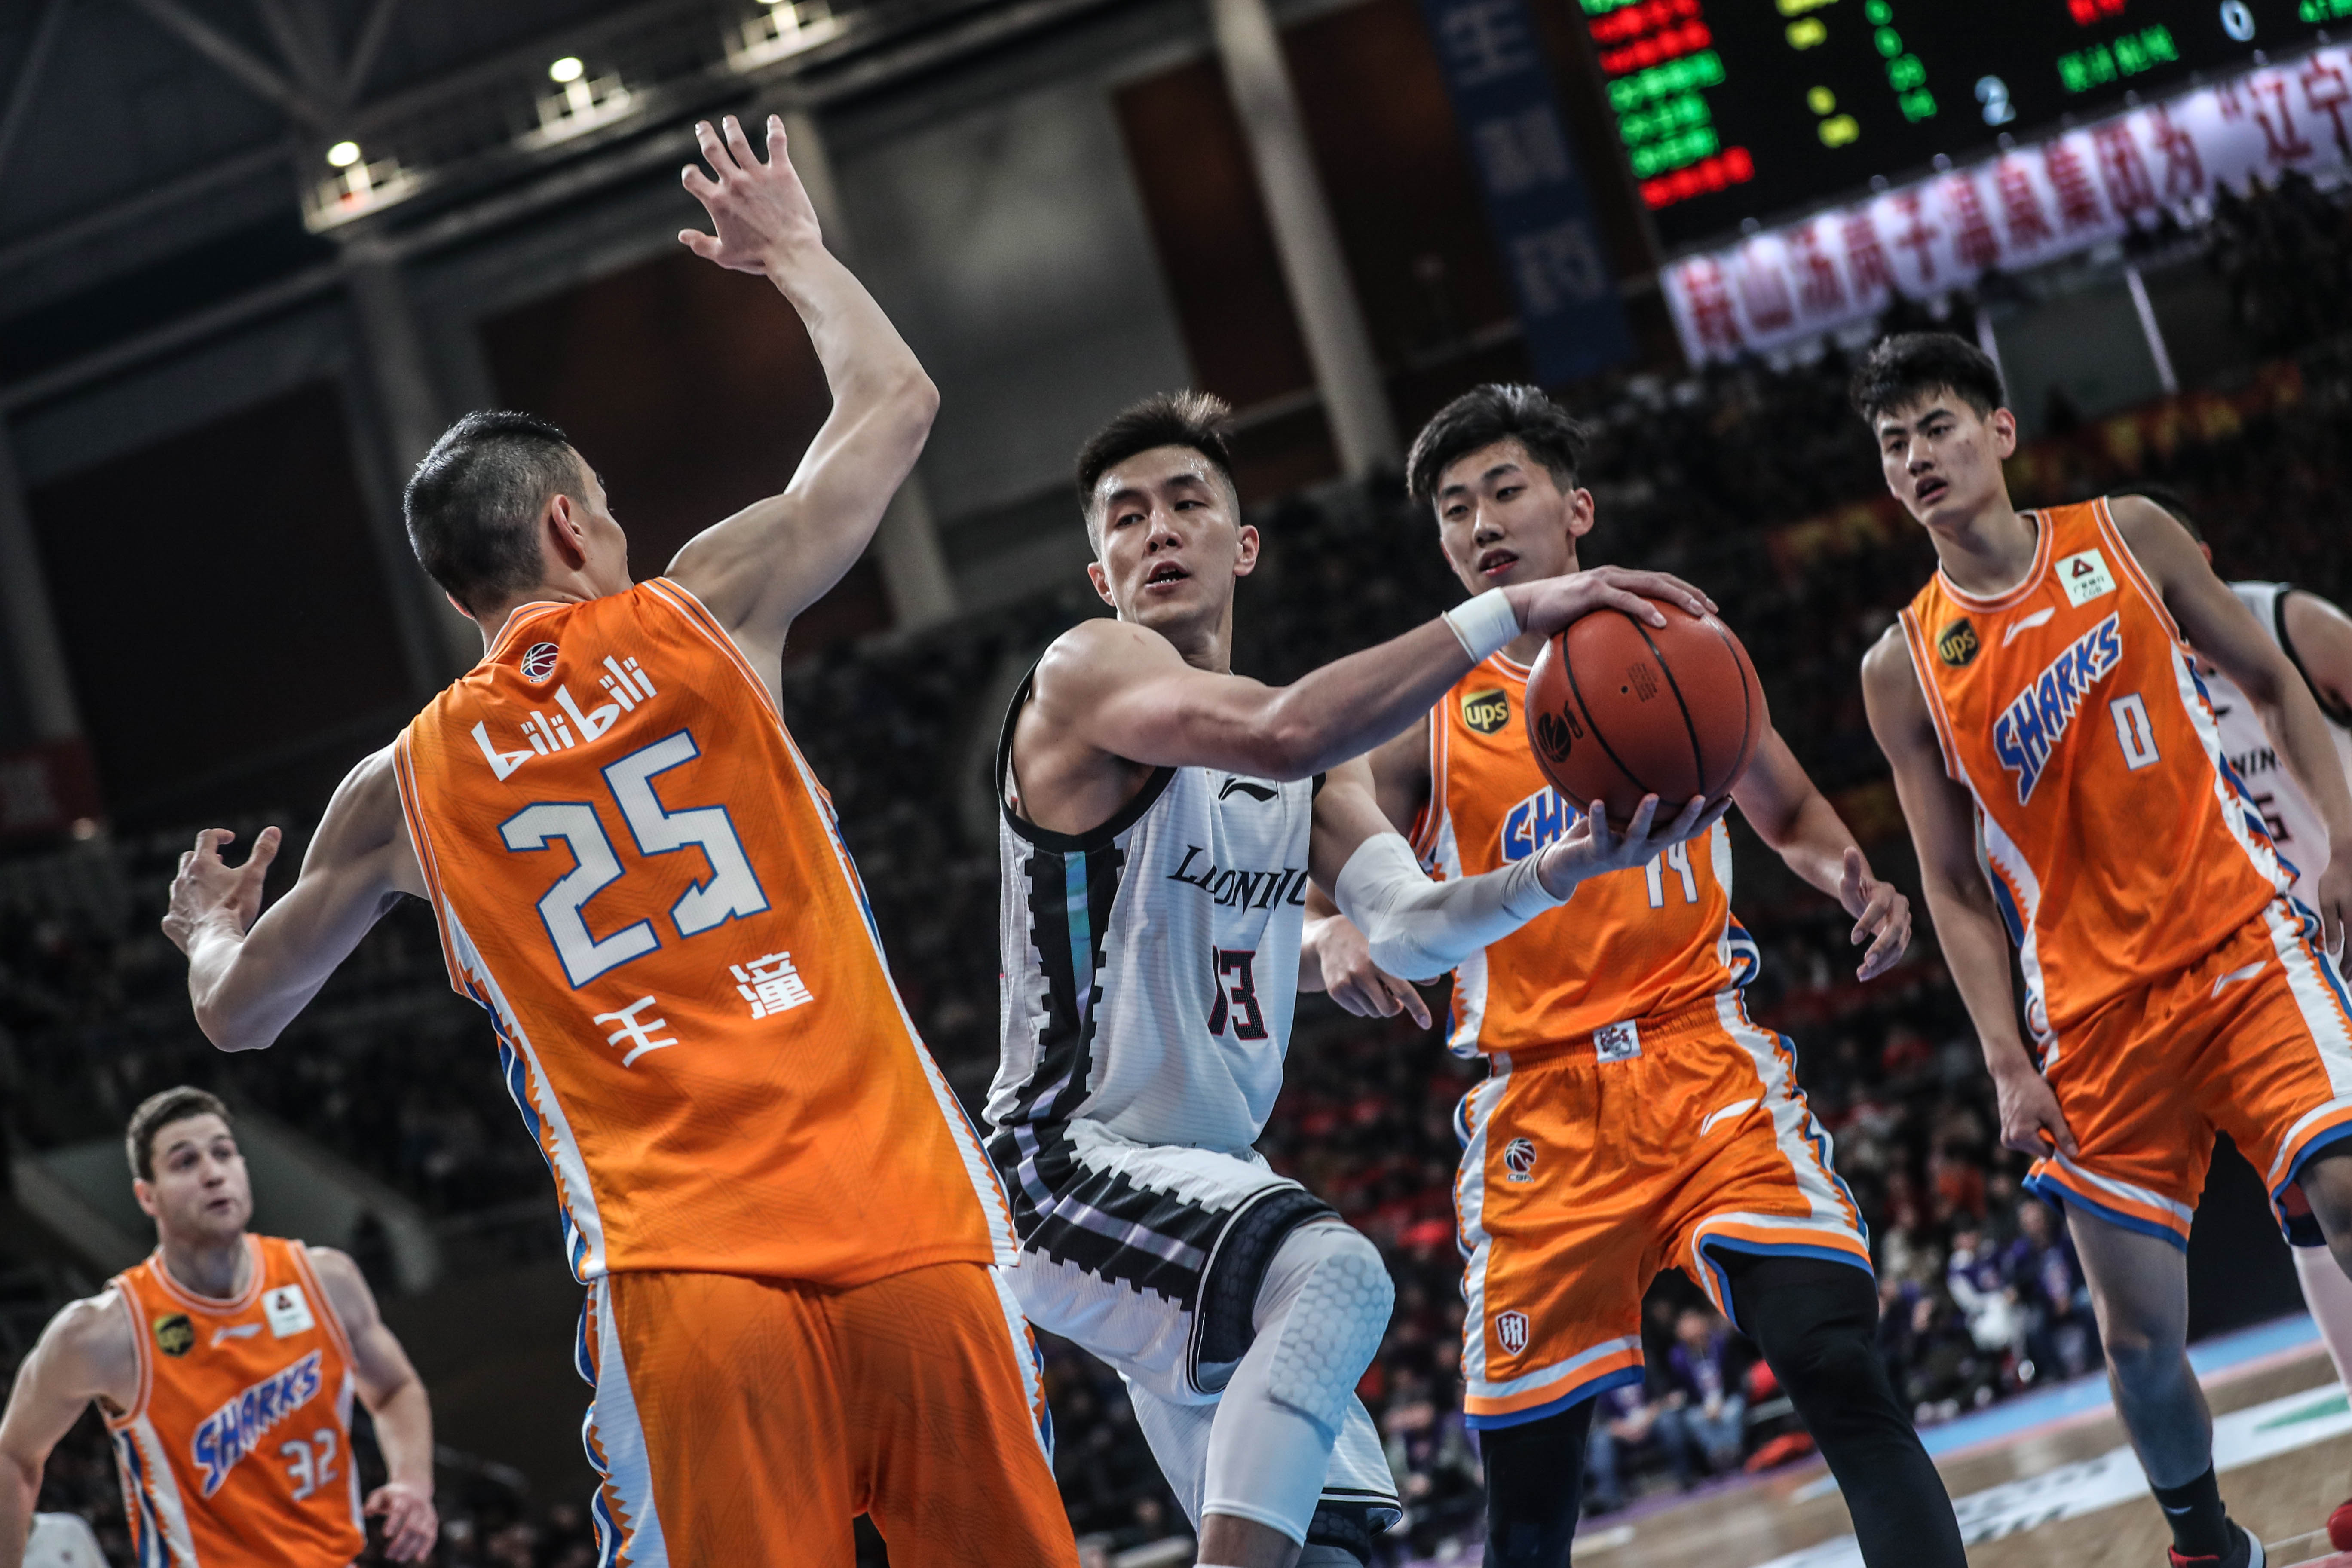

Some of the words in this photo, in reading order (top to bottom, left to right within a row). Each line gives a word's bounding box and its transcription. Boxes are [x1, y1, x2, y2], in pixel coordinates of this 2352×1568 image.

[1940, 629, 1976, 662] ups
[471, 655, 658, 781] bilibili
[1466, 701, 1508, 729] ups
[1993, 609, 2122, 806] SHARKS
[2109, 692, 2161, 771] 0
[497, 727, 772, 991] 25
[1207, 944, 1268, 1041] 13
[190, 1348, 322, 1499] SHARKS
[280, 1427, 338, 1501] 32
